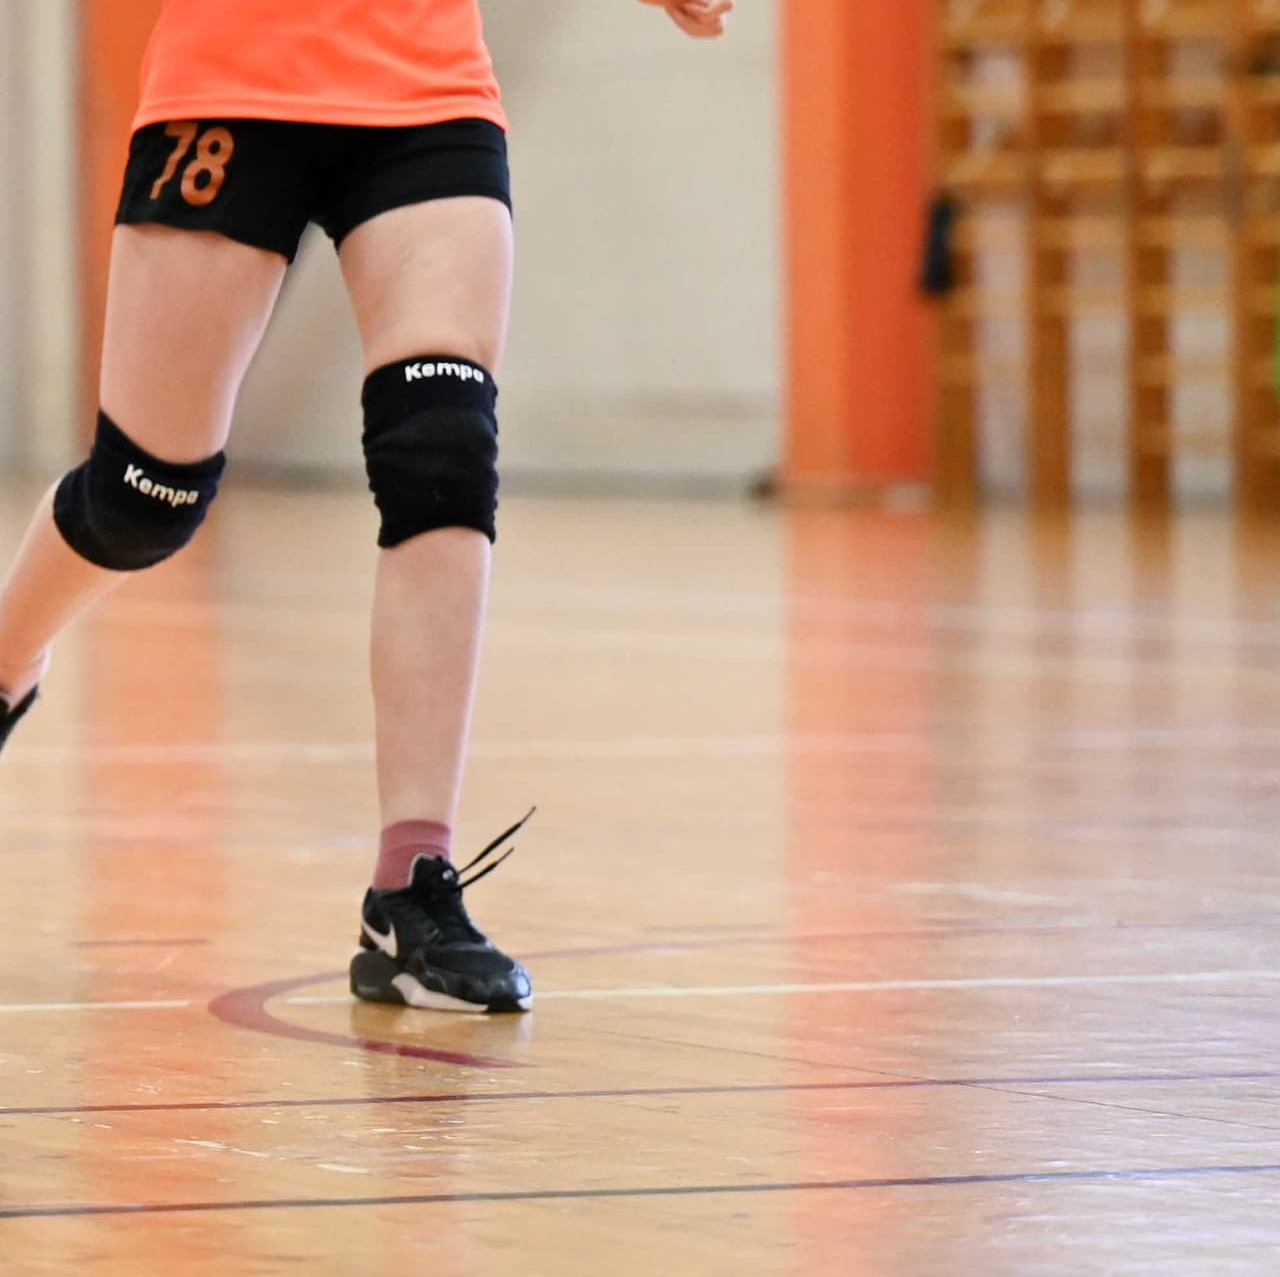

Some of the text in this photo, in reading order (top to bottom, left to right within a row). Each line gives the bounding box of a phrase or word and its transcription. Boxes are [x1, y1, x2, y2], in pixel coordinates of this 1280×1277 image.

[149, 121, 235, 208] 78
[404, 362, 485, 384] Kempa
[123, 462, 200, 509] Kempa
